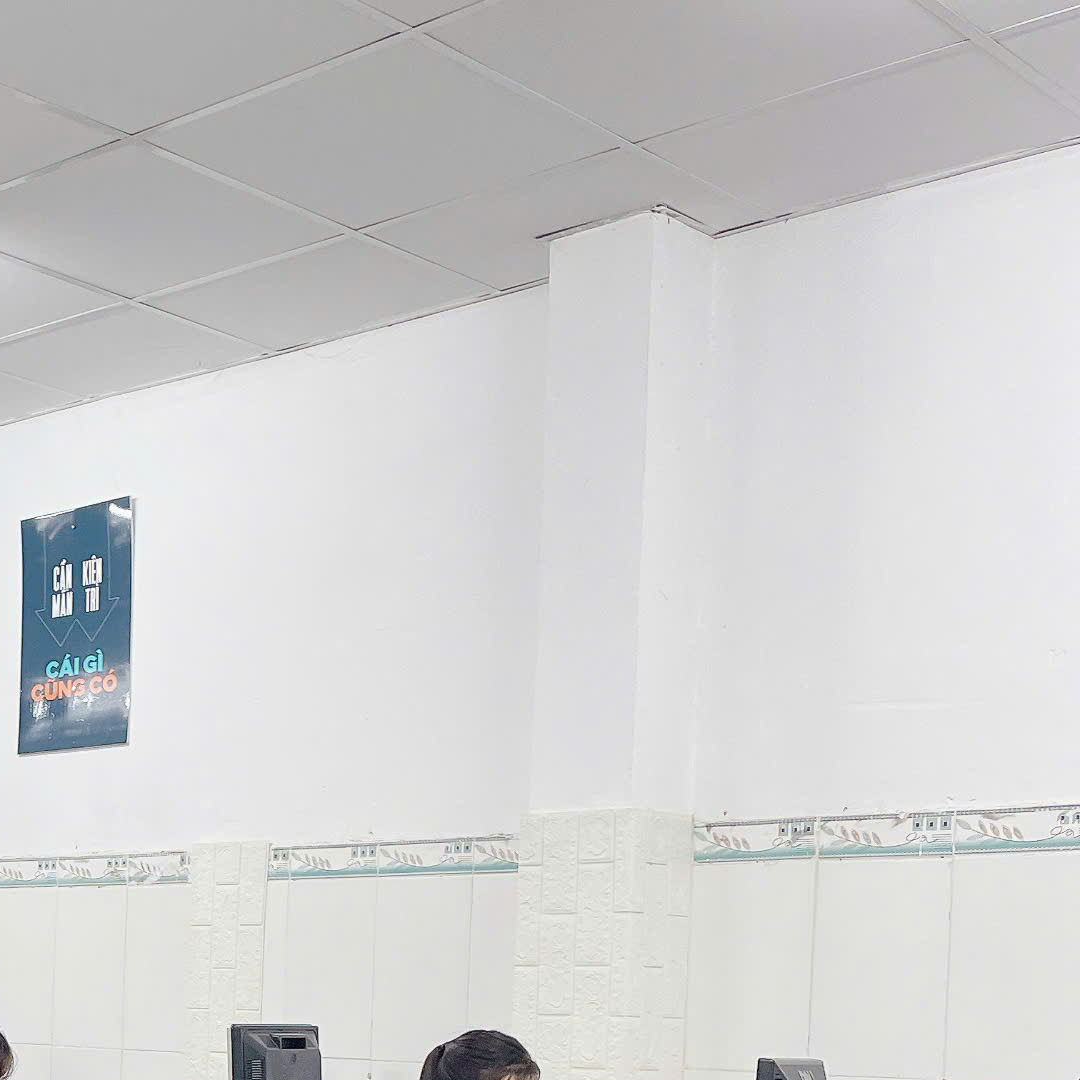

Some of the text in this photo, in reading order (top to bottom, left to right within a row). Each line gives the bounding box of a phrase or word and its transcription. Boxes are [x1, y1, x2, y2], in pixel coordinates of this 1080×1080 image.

[45, 648, 104, 679] CÁI GÌ
[31, 668, 118, 702] CŨNG CÓ
